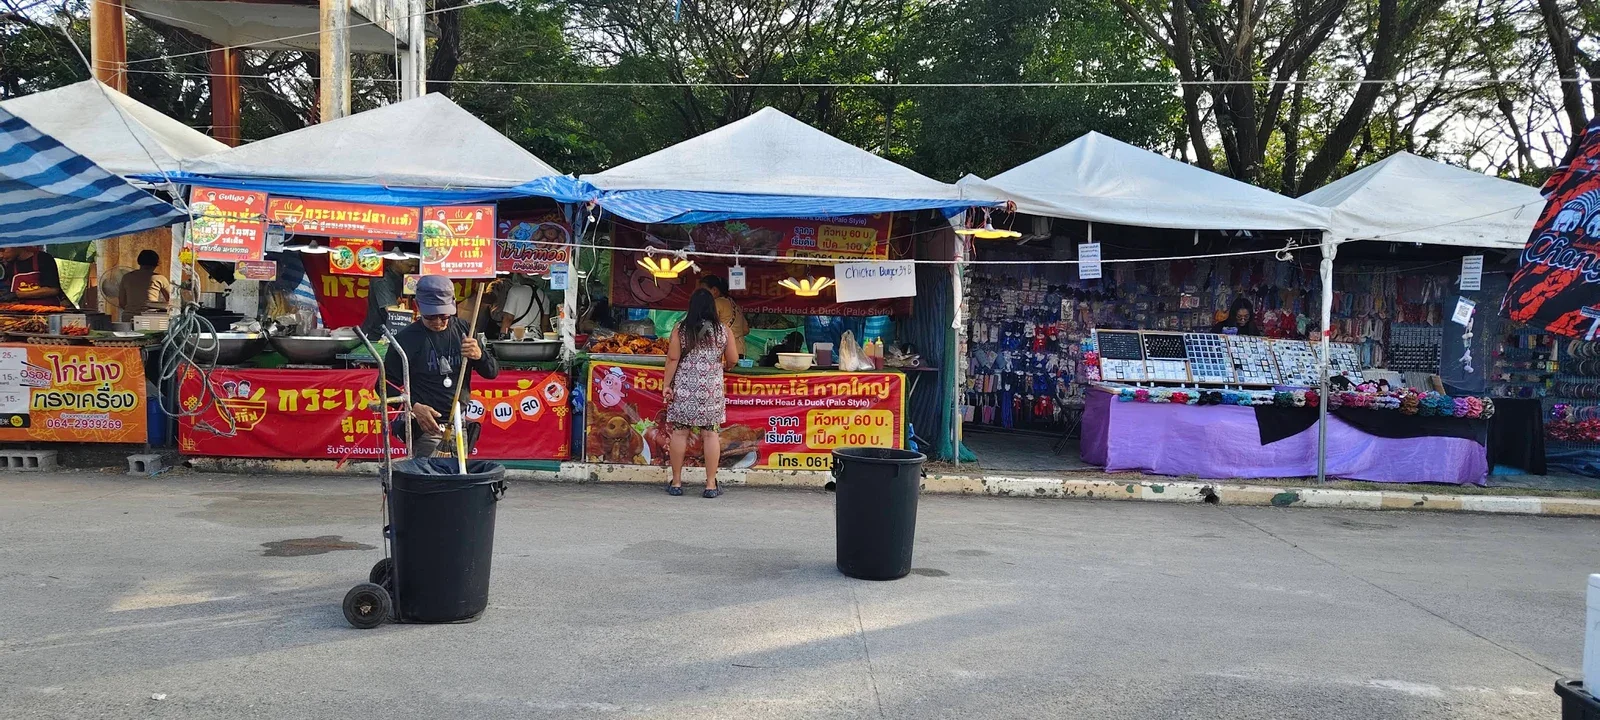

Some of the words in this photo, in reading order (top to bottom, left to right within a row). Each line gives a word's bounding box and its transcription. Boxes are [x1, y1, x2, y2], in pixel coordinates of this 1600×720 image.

[794, 227, 815, 235] ราคา
[823, 228, 848, 240] หัวหมู
[850, 229, 861, 238] 60
[762, 306, 783, 314] Pork
[785, 307, 808, 315] Head
[818, 307, 841, 315] Duck
[47, 354, 121, 383] ไก่ย่าง
[732, 377, 810, 396] เป็ดพะโล้
[813, 376, 890, 399] หาดใหญ่
[33, 382, 135, 409] ทรงเครื่อง
[724, 397, 754, 406] Braised
[755, 398, 773, 406] Pork
[774, 398, 796, 407] Head
[797, 399, 803, 407] &
[804, 399, 825, 407] Duck
[826, 398, 846, 407] (Palo
[847, 399, 870, 408] Style)
[521, 399, 539, 412] สด
[768, 415, 799, 426] ราคา
[813, 412, 850, 429] หัวหมู
[854, 414, 871, 426] 60
[875, 416, 889, 427] บ.
[765, 426, 802, 444] เริ่มต้น
[813, 429, 837, 445] เป็ด
[841, 433, 867, 445] 100
[870, 434, 884, 446] บ.
[778, 454, 802, 467] โทร.
[806, 456, 835, 468] 061-
